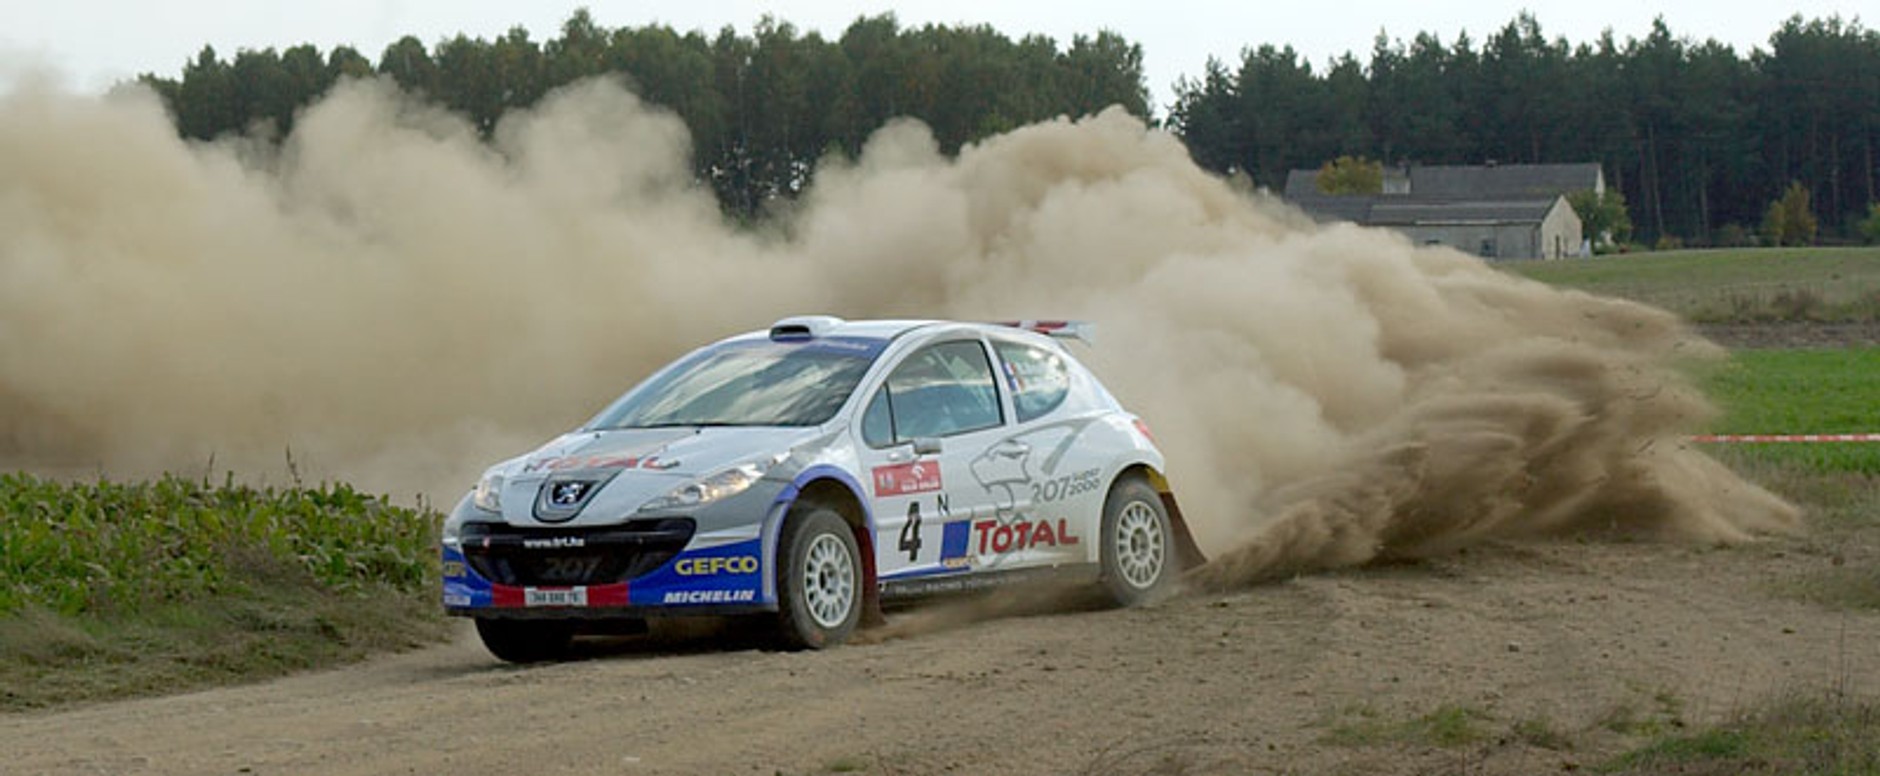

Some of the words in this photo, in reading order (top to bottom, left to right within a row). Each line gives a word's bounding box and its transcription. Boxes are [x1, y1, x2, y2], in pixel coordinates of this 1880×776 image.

[1032, 475, 1070, 504] 207
[937, 493, 949, 516] N
[898, 501, 922, 562] 4
[974, 519, 1079, 556] TOTAL
[674, 556, 758, 575] GEFCO
[664, 589, 755, 603] MICHELIN
